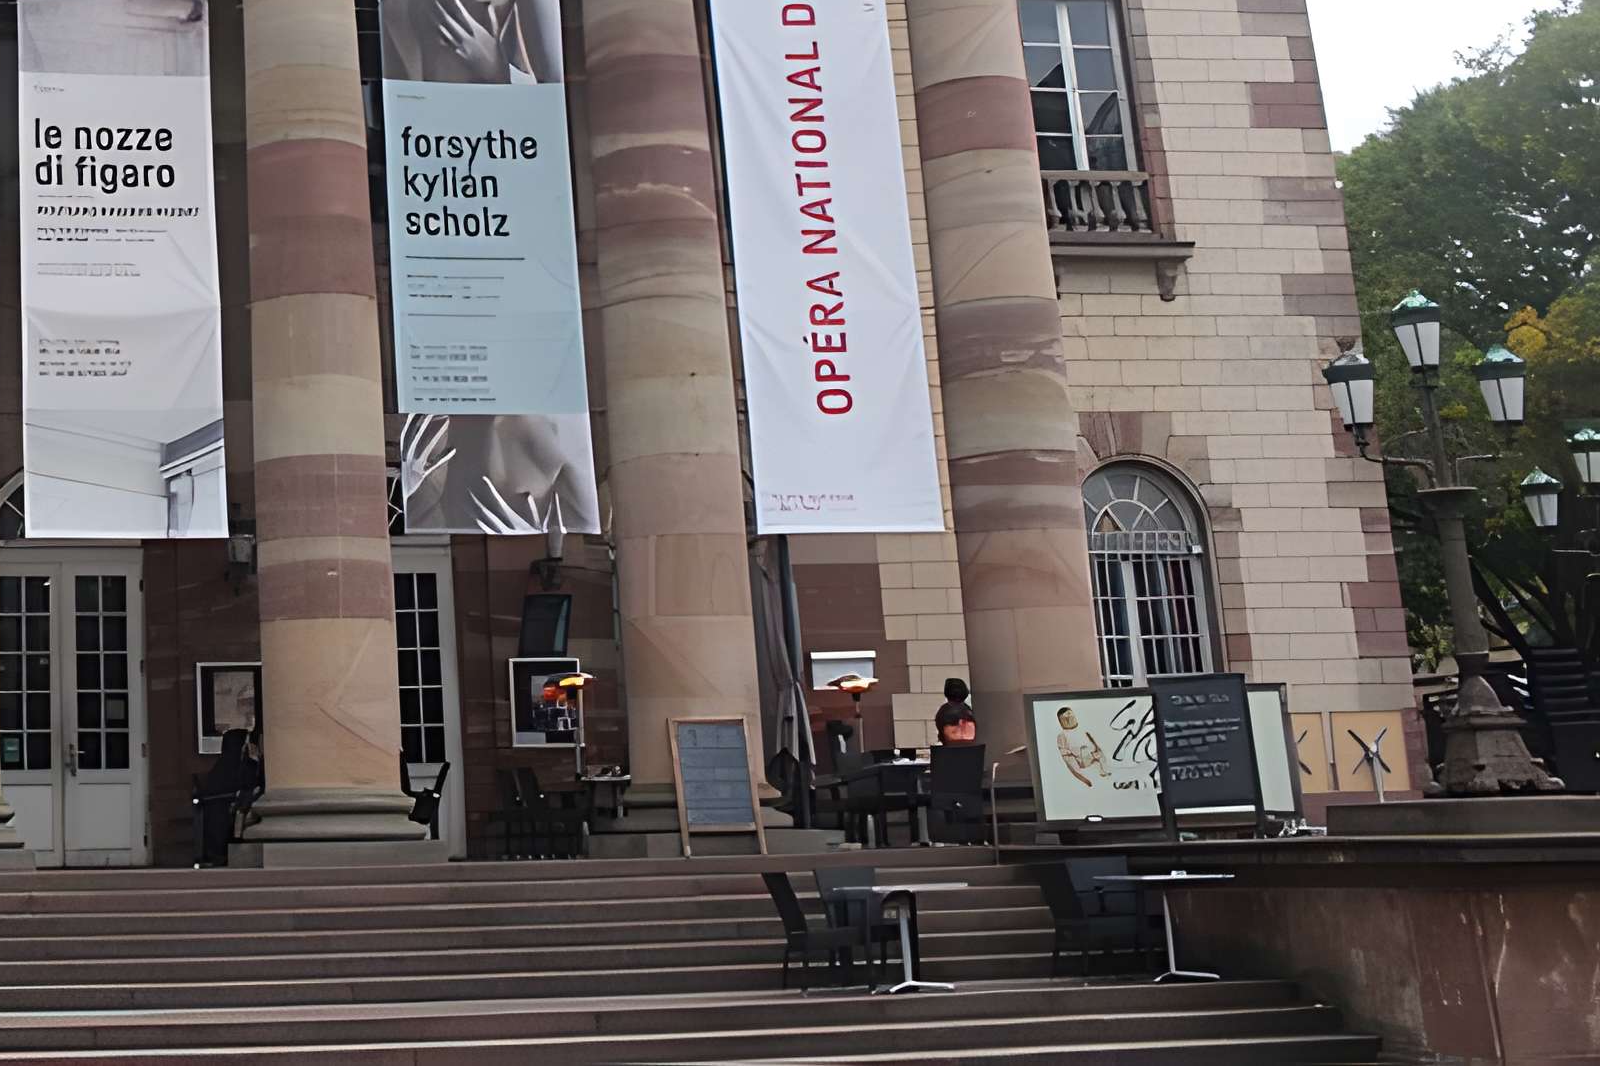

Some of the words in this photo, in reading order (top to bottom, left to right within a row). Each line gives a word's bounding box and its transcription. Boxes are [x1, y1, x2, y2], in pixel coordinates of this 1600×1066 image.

[34, 117, 62, 149] le
[74, 126, 173, 151] nozze
[401, 126, 538, 171] forsythe
[785, 41, 839, 254] NATIONAL
[35, 154, 63, 186] di
[74, 155, 175, 194] figaro
[406, 205, 510, 237] scholz
[803, 271, 853, 415] OPÉRA
